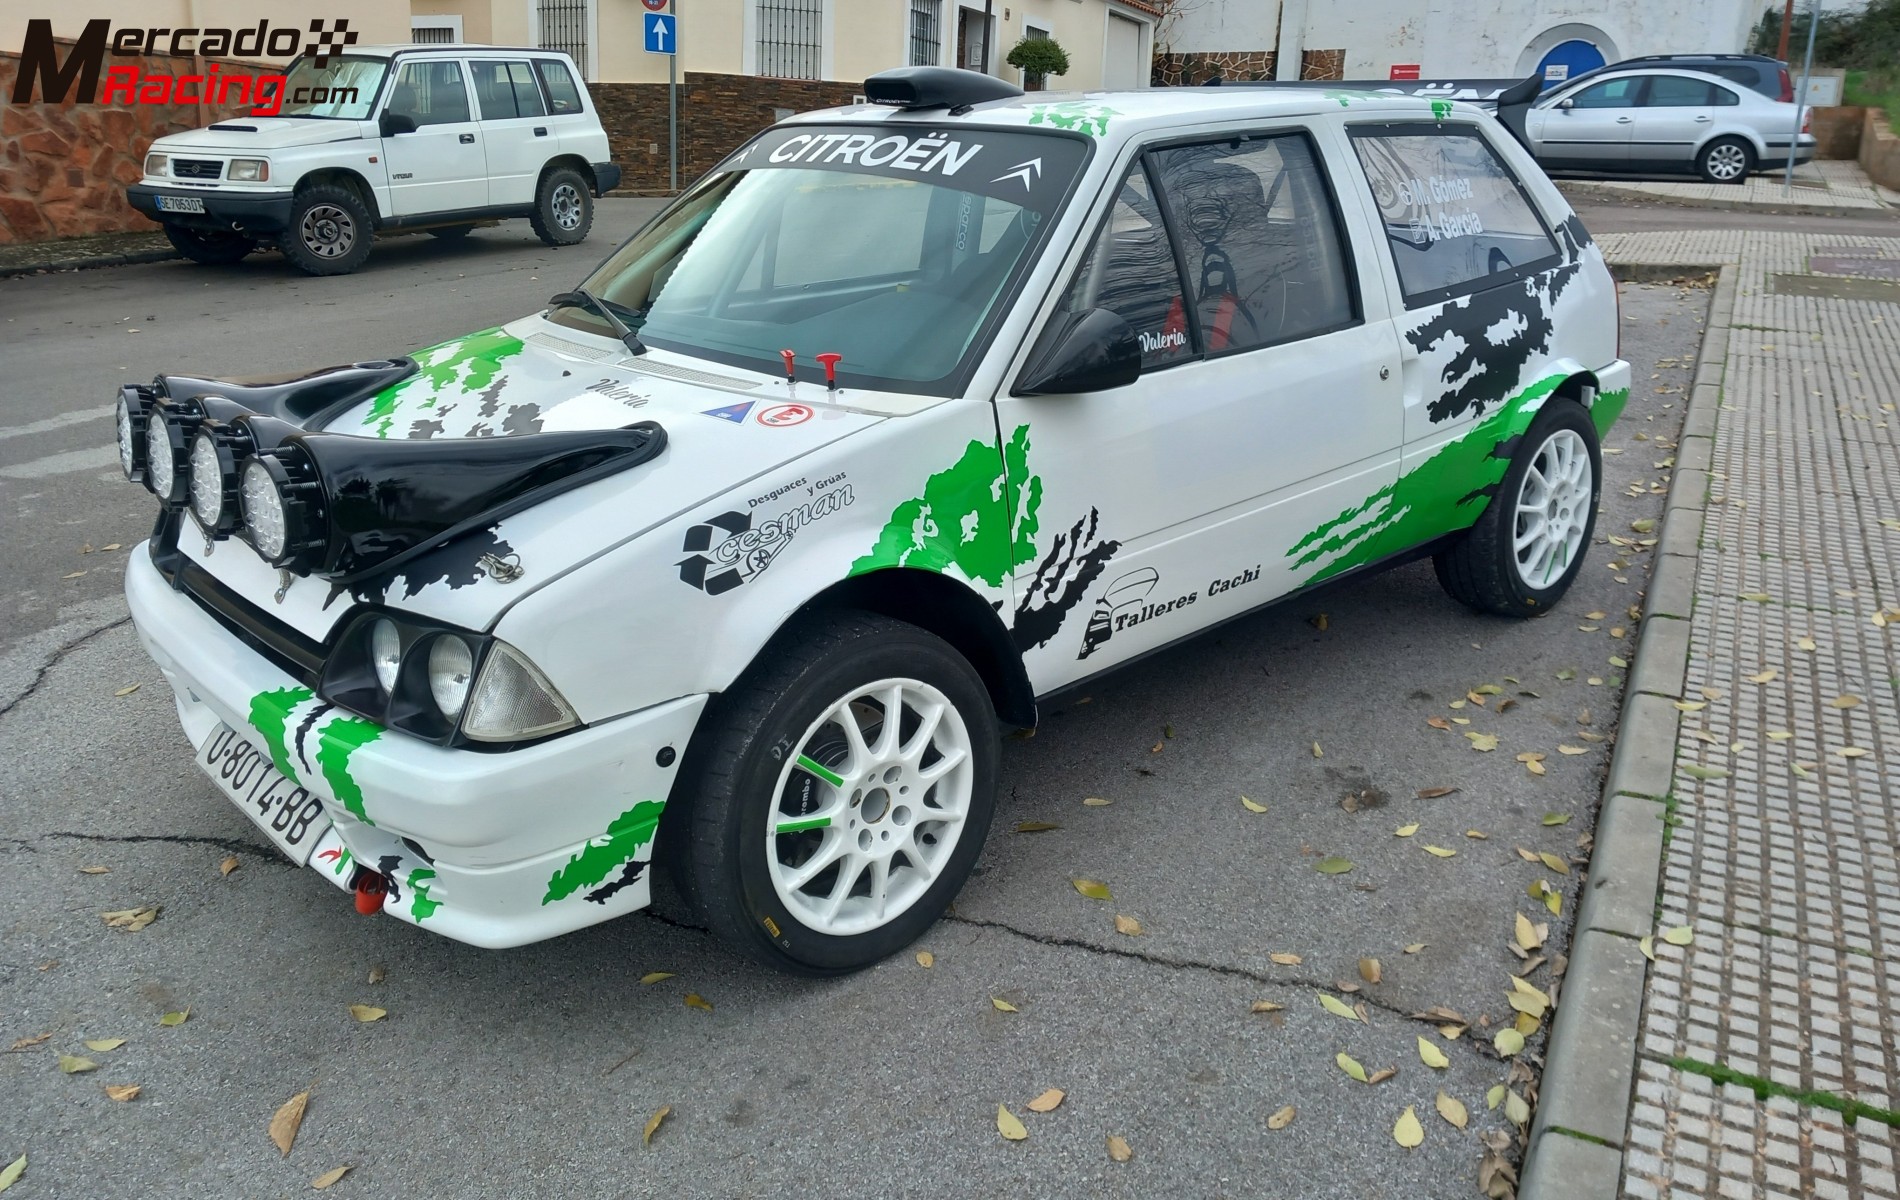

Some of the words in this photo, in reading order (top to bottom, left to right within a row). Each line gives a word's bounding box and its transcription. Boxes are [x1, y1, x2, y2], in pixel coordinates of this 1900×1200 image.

[768, 131, 984, 177] CITROËN
[1411, 178, 1431, 206] M.
[1429, 174, 1474, 204] Gómez
[1425, 214, 1441, 242] A.
[1439, 207, 1484, 239] García
[1138, 327, 1187, 353] Valeria
[585, 378, 652, 408] Valeria
[747, 476, 808, 509] Desguaces
[806, 487, 815, 497] y
[815, 471, 847, 491] Grúas
[1115, 591, 1198, 632] Talleres
[1208, 564, 1261, 598] Cachi
